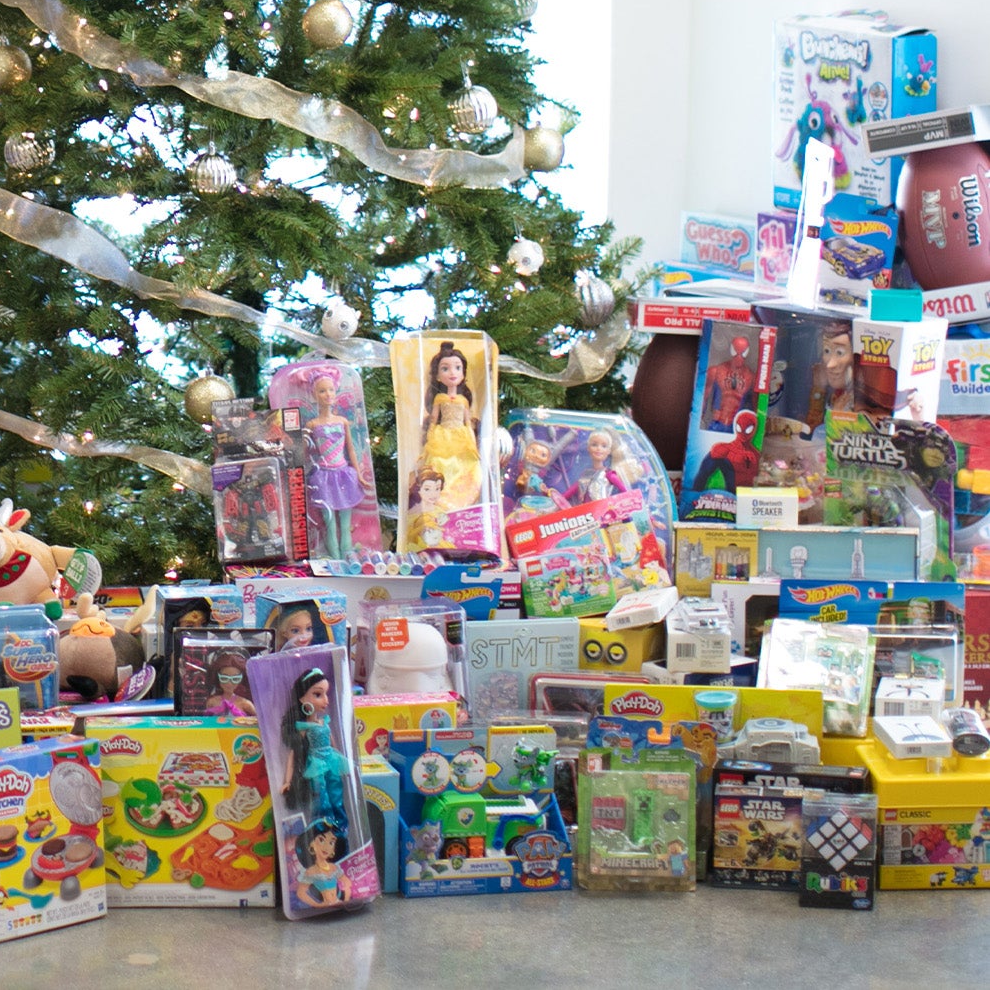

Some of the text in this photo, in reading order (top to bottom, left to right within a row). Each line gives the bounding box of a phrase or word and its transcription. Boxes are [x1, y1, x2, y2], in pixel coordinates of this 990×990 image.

[923, 130, 944, 141] MVP
[960, 175, 982, 248] Wilson
[686, 220, 732, 245] GUESS
[922, 294, 976, 317] Wils
[664, 317, 683, 326] PRO
[861, 335, 894, 355] TOY
[913, 340, 940, 360] TOY
[863, 354, 889, 363] STORY
[947, 359, 990, 383] firs
[952, 384, 990, 394] Builde
[843, 434, 895, 448] NINJA
[831, 442, 907, 469] TURTLES
[288, 468, 308, 559] TRANSFORMERS
[752, 507, 783, 516] SPEAKER
[539, 513, 595, 539] JUNIORS
[821, 606, 836, 614] CAR
[16, 653, 56, 668] HERO
[471, 637, 559, 669] STMT
[612, 695, 662, 714] Play-Doh
[100, 737, 141, 754] Play-Doh
[719, 800, 786, 813] LEGO STAR
[743, 809, 786, 821] WARS
[900, 811, 931, 819] CLASSIC
[515, 834, 567, 860] PAW
[526, 861, 554, 869] PATROL
[601, 858, 669, 869] MINECRAFT
[525, 877, 555, 885] ALL-STARS
